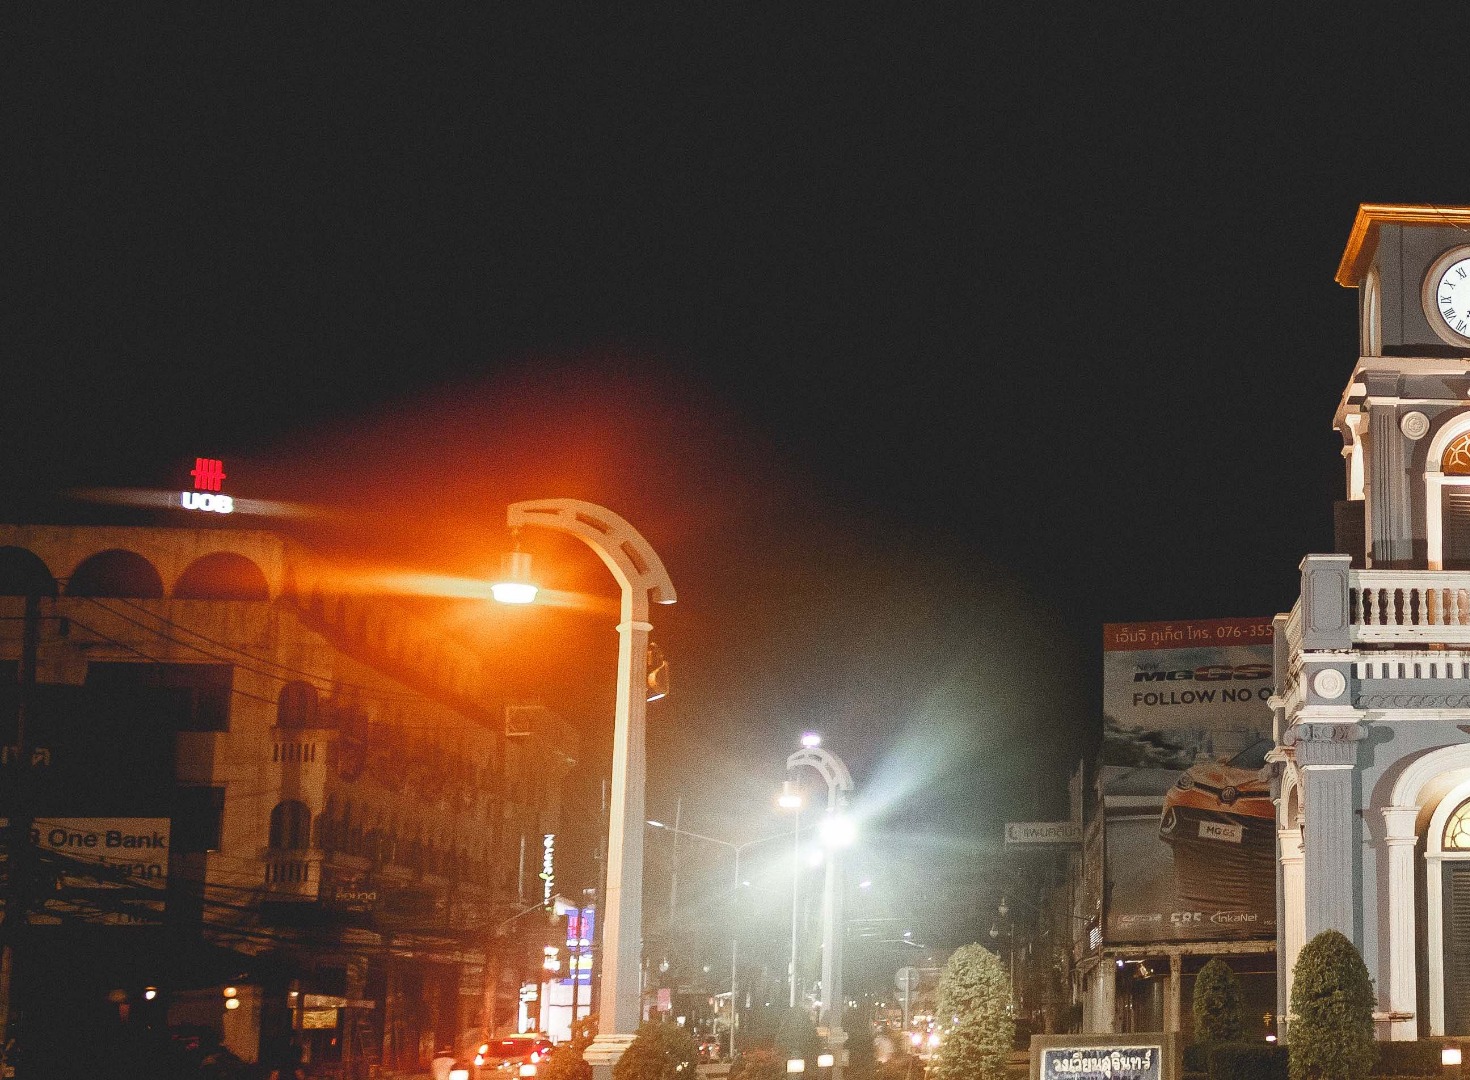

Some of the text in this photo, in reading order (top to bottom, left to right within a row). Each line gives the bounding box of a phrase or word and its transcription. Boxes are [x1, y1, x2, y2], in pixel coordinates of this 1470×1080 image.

[181, 491, 234, 514] UOB
[1115, 627, 1147, 643] เอ็มจี
[1151, 625, 1184, 646] ภูเก็ต
[1187, 626, 1212, 640] โทร.
[1132, 687, 1275, 707] FOLLOW NO O
[48, 829, 97, 848] One
[105, 830, 166, 849] Bank
[1053, 1050, 1151, 1079] วงเวียนสุรินทร์
